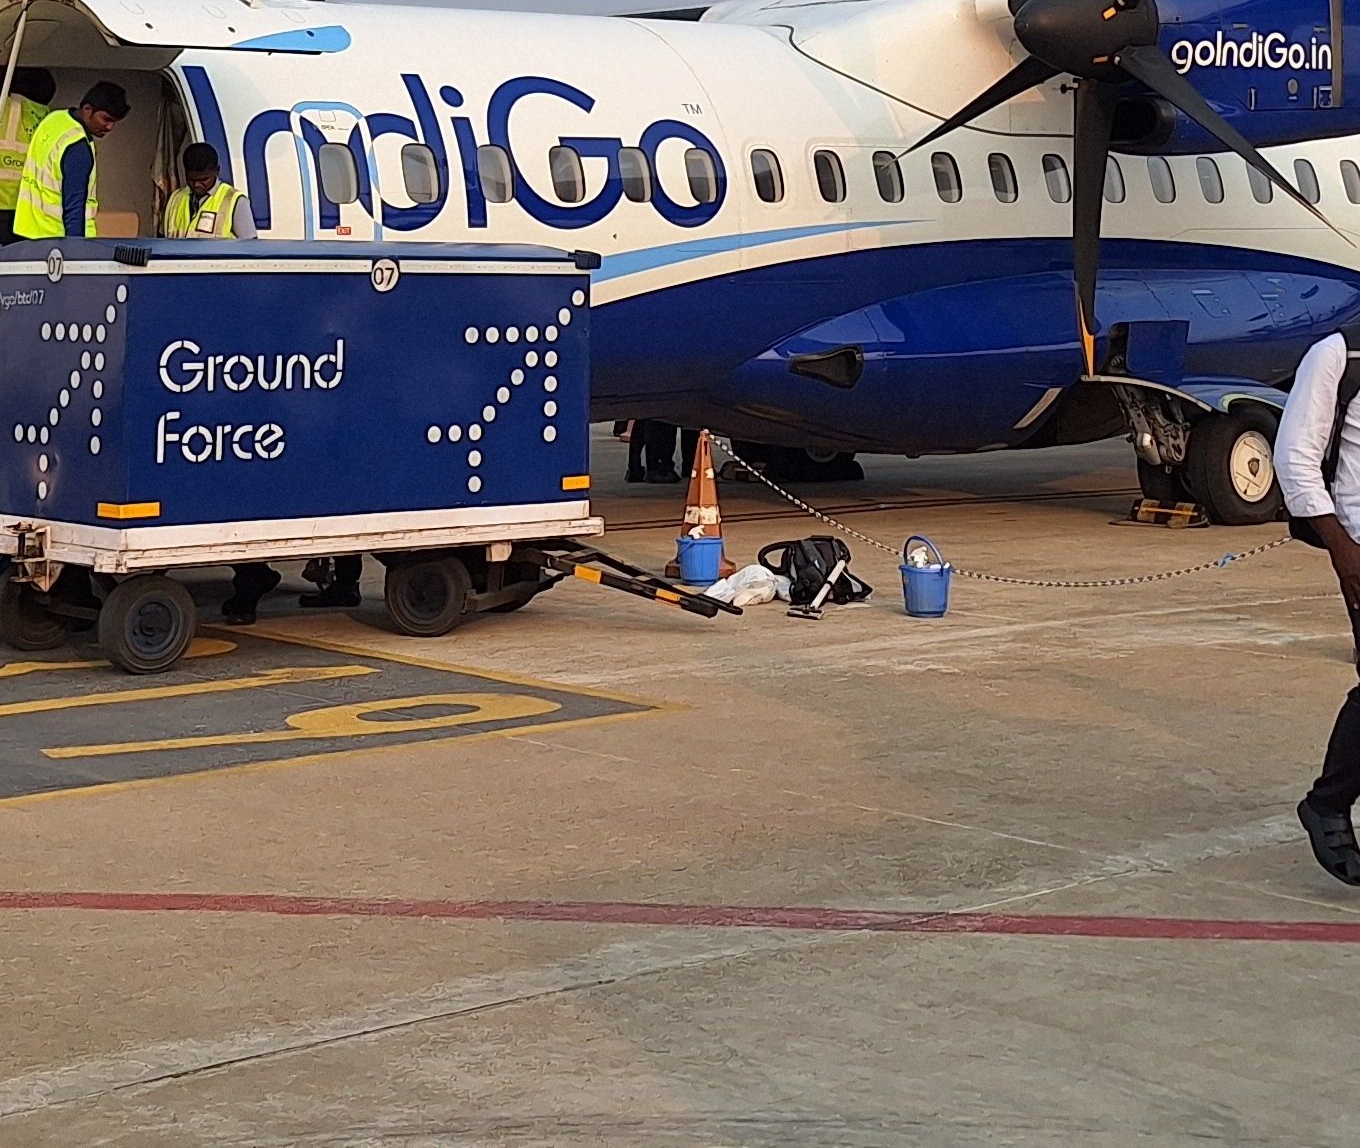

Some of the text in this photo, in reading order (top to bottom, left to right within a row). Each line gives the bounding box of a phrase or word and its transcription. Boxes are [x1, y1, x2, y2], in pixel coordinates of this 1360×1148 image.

[1171, 30, 1332, 75] goIndiGo.in
[181, 65, 728, 232] IndiGo TM
[48, 257, 62, 276] 07
[374, 267, 394, 288] 07
[159, 339, 344, 393] Ground
[156, 411, 285, 464] Force
